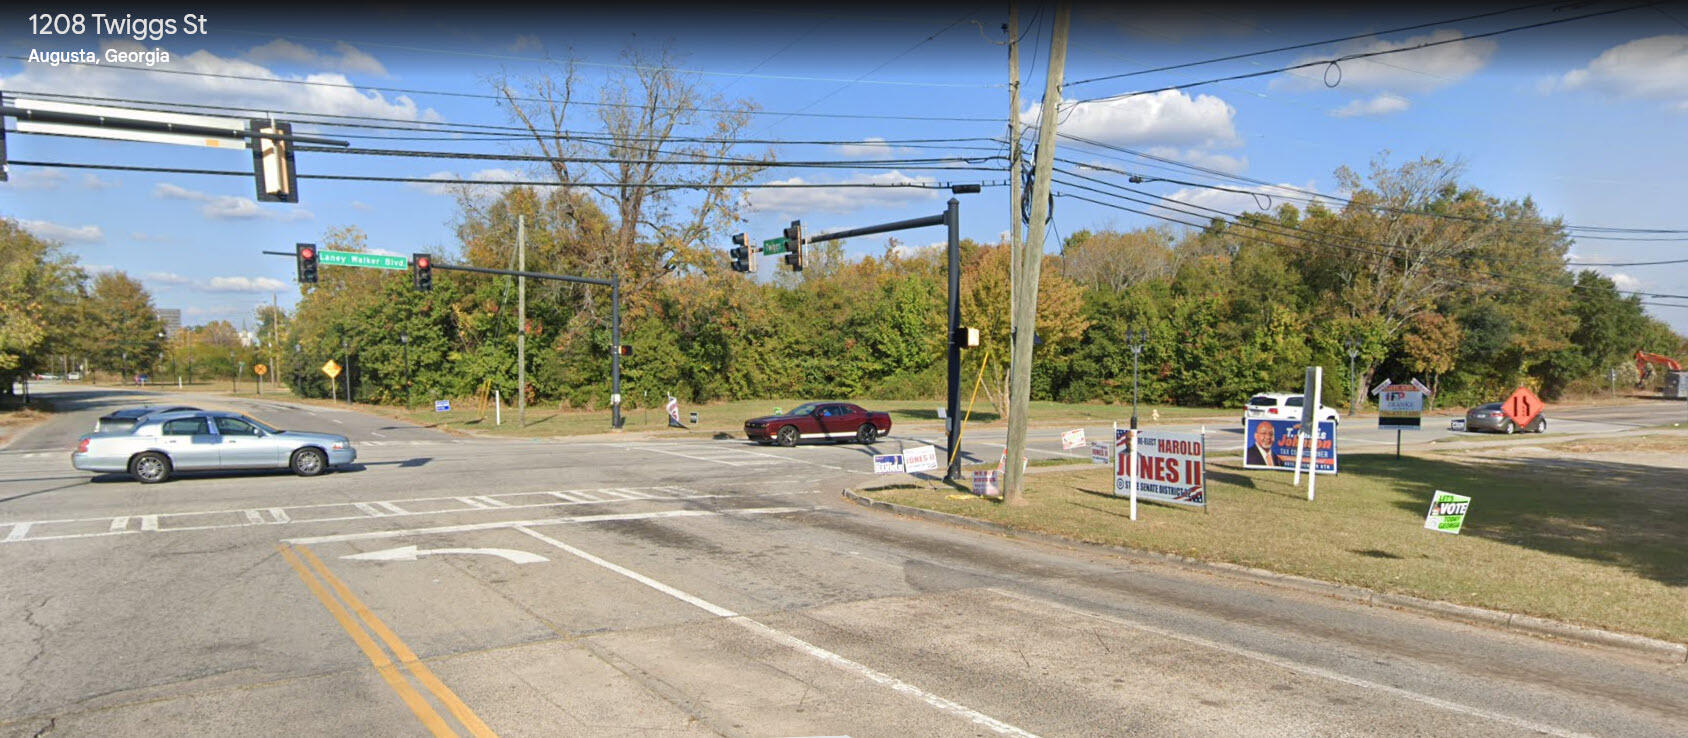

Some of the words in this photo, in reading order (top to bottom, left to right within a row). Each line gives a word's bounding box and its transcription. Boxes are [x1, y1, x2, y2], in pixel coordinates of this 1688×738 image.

[320, 254, 346, 264] Laney
[351, 256, 380, 265] Walker
[385, 258, 403, 266] Blvd
[1158, 439, 1201, 456] HAROLD
[906, 455, 928, 465] JONES
[1185, 460, 1201, 486] II
[1125, 480, 1139, 491] STE
[1140, 482, 1158, 494] SENATE
[1440, 502, 1468, 515] VOTE
